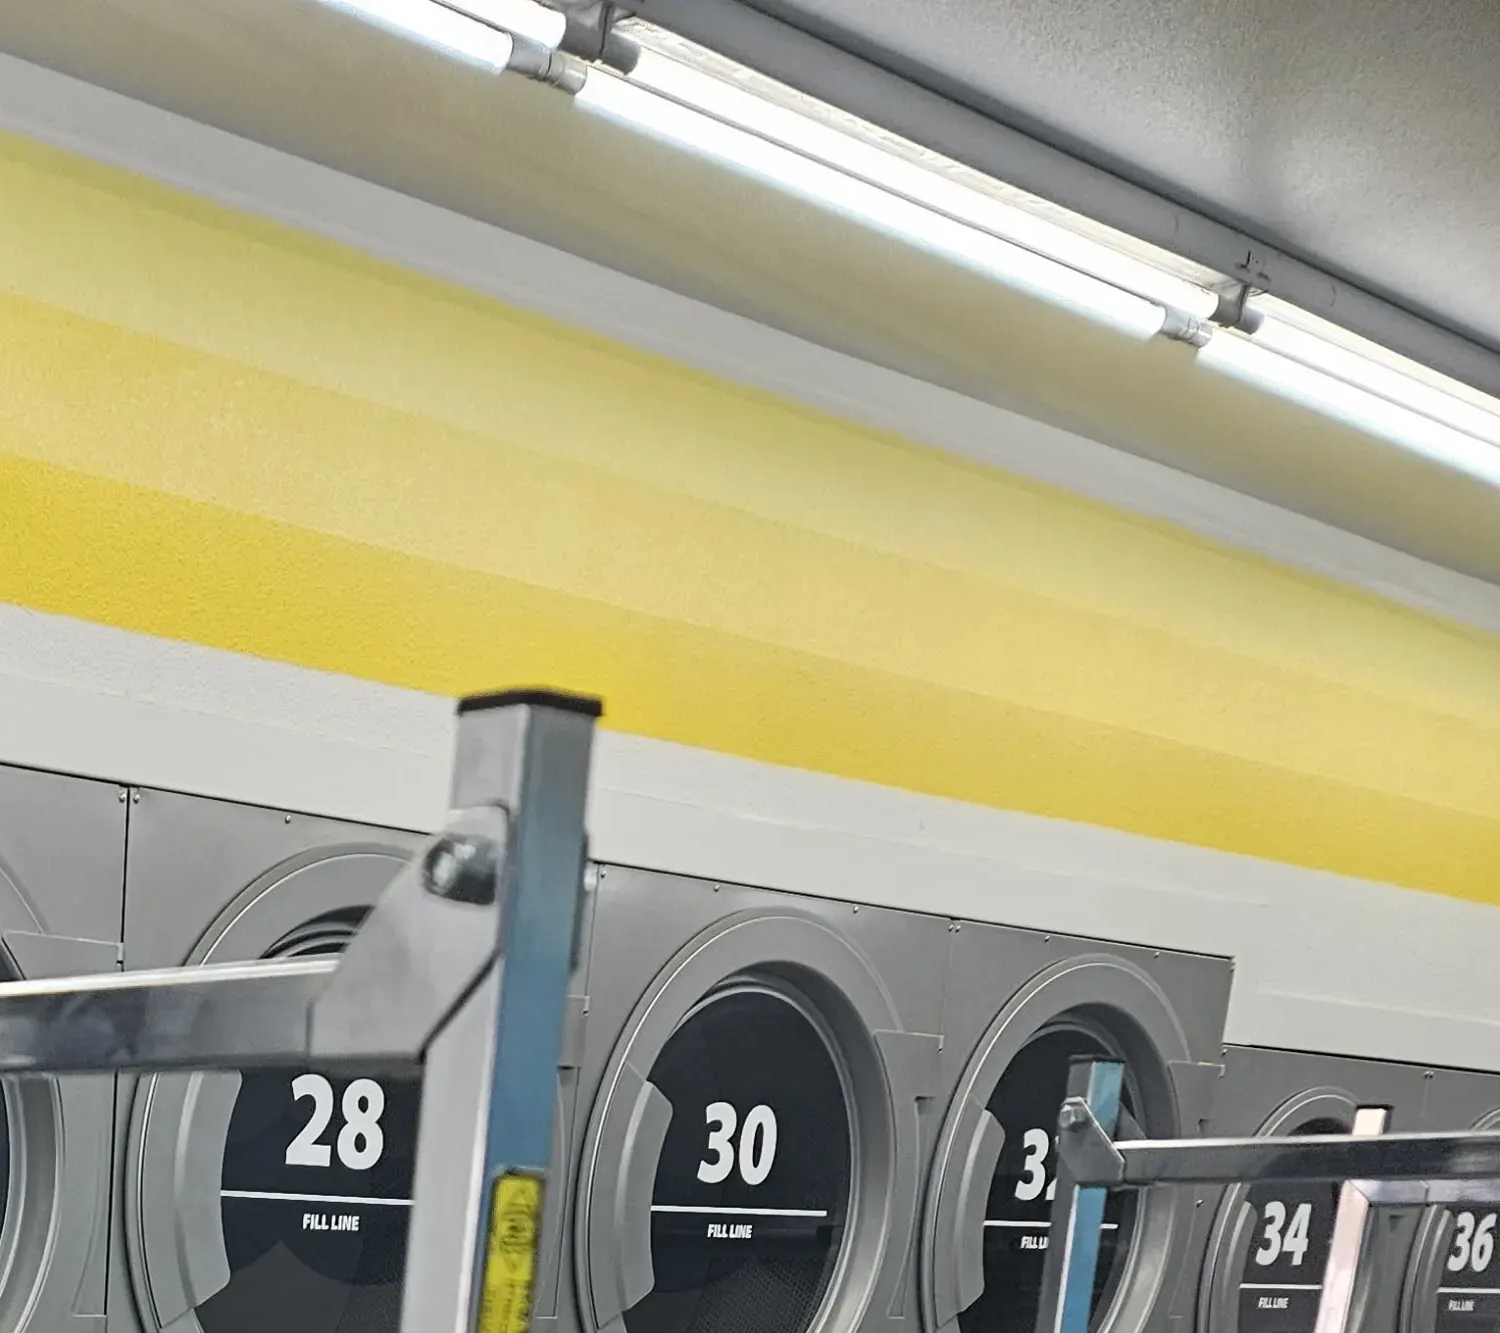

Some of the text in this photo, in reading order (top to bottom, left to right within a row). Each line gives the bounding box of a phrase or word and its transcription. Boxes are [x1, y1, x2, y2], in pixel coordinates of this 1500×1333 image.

[285, 1073, 385, 1171] 28
[696, 1101, 778, 1186] 30
[302, 1213, 360, 1231] FILL LINE
[707, 1224, 753, 1239] FILL LINE
[1020, 1236, 1049, 1249] FILL LI
[1255, 1201, 1312, 1266] 34
[1447, 1211, 1497, 1272] 36
